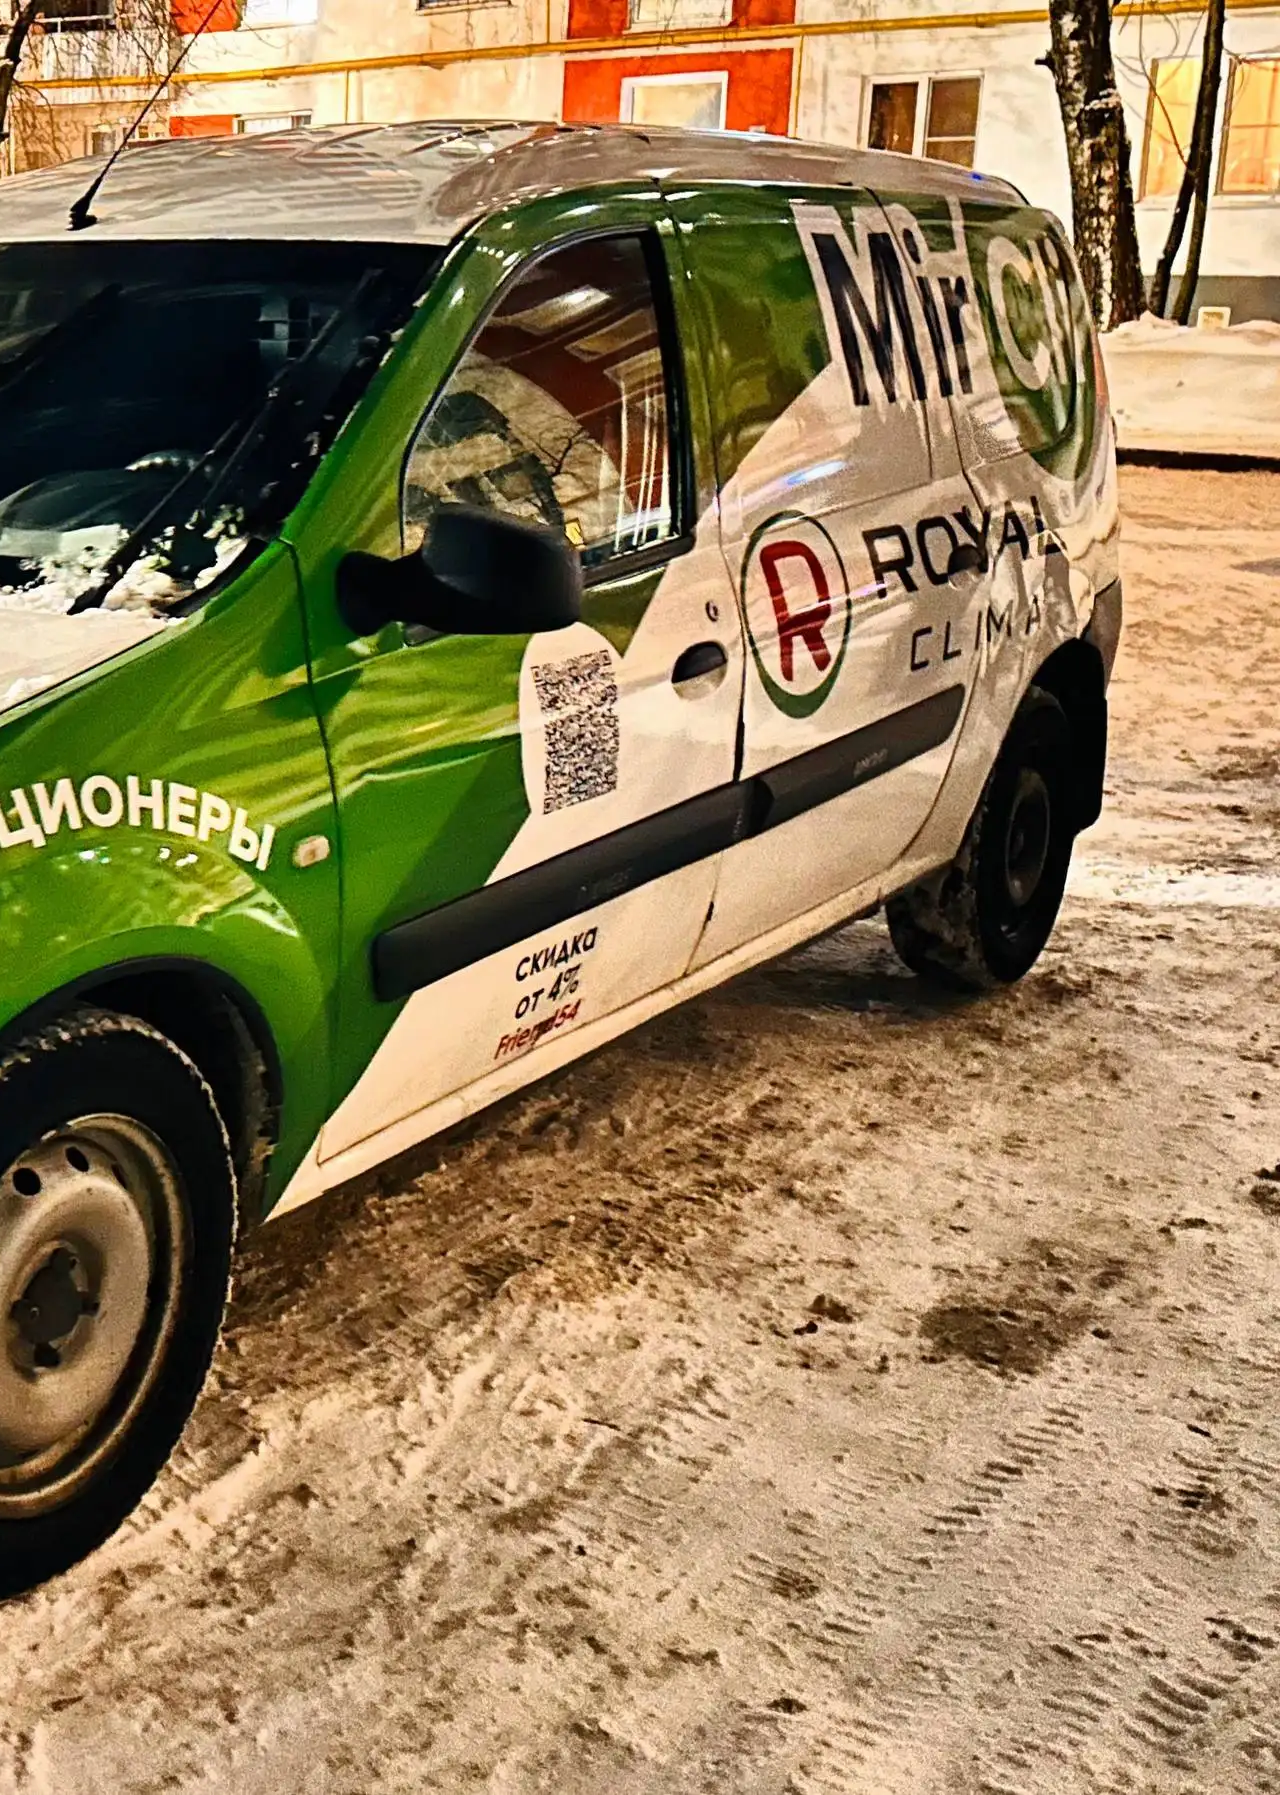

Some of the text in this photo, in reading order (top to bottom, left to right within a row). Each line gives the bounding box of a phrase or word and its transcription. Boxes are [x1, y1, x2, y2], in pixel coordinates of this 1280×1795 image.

[811, 228, 973, 406] Mir
[862, 495, 1068, 599] ROYAL
[760, 540, 833, 682] R
[547, 963, 583, 1001] 4%
